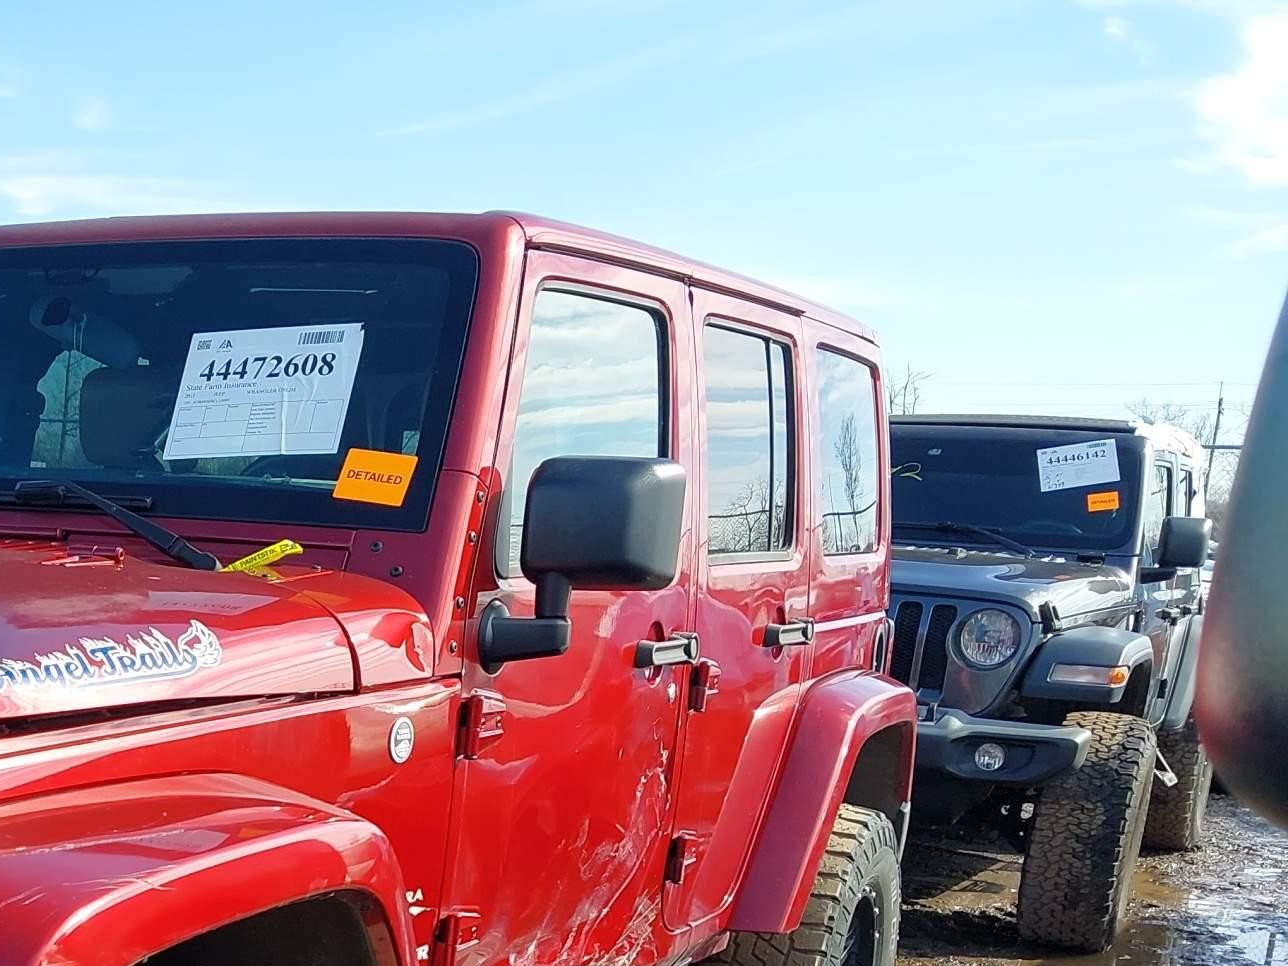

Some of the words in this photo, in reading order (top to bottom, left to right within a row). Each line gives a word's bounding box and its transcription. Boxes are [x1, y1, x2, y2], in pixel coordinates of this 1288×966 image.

[199, 352, 337, 382] 44472608
[185, 383, 203, 392] State
[204, 382, 223, 391] Farm
[223, 380, 258, 390] Insurance
[1046, 449, 1106, 464] 44446142
[346, 469, 403, 486] DETAILED
